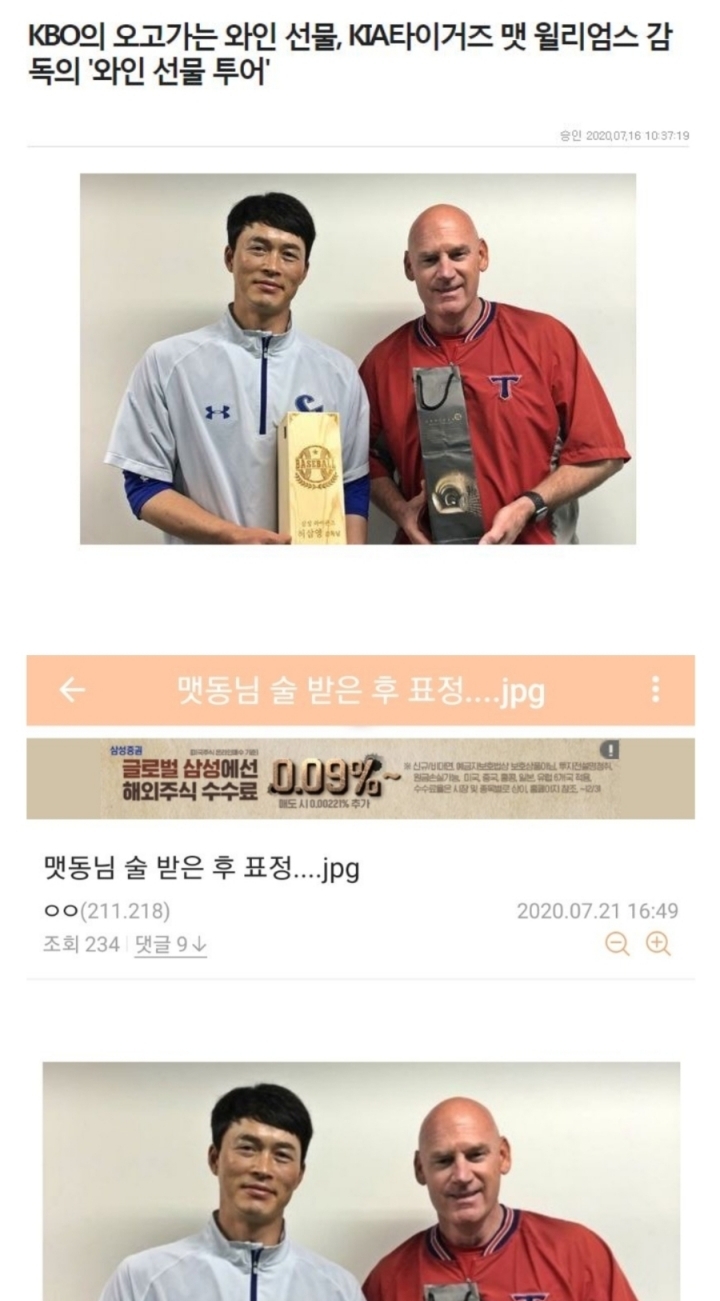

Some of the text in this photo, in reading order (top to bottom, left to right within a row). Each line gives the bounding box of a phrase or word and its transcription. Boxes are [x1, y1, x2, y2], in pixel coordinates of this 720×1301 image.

[488, 375, 521, 400] T
[295, 458, 336, 470] BASEBALL
[178, 676, 545, 709] 맷동님 술 받은 후 표정....jpg
[110, 745, 142, 756] 삼성증권
[122, 758, 258, 779] 글로벌 삼성에선
[122, 782, 258, 801] 해외주식 수수료
[279, 799, 297, 809] 매도
[299, 799, 308, 809] 시
[351, 799, 370, 809] 추가
[45, 856, 360, 884] 맷동님 술 받은 후 표정....jpg
[517, 902, 679, 920] 2020.07.21 16:49
[43, 935, 188, 954] 조회 234 댓글 9
